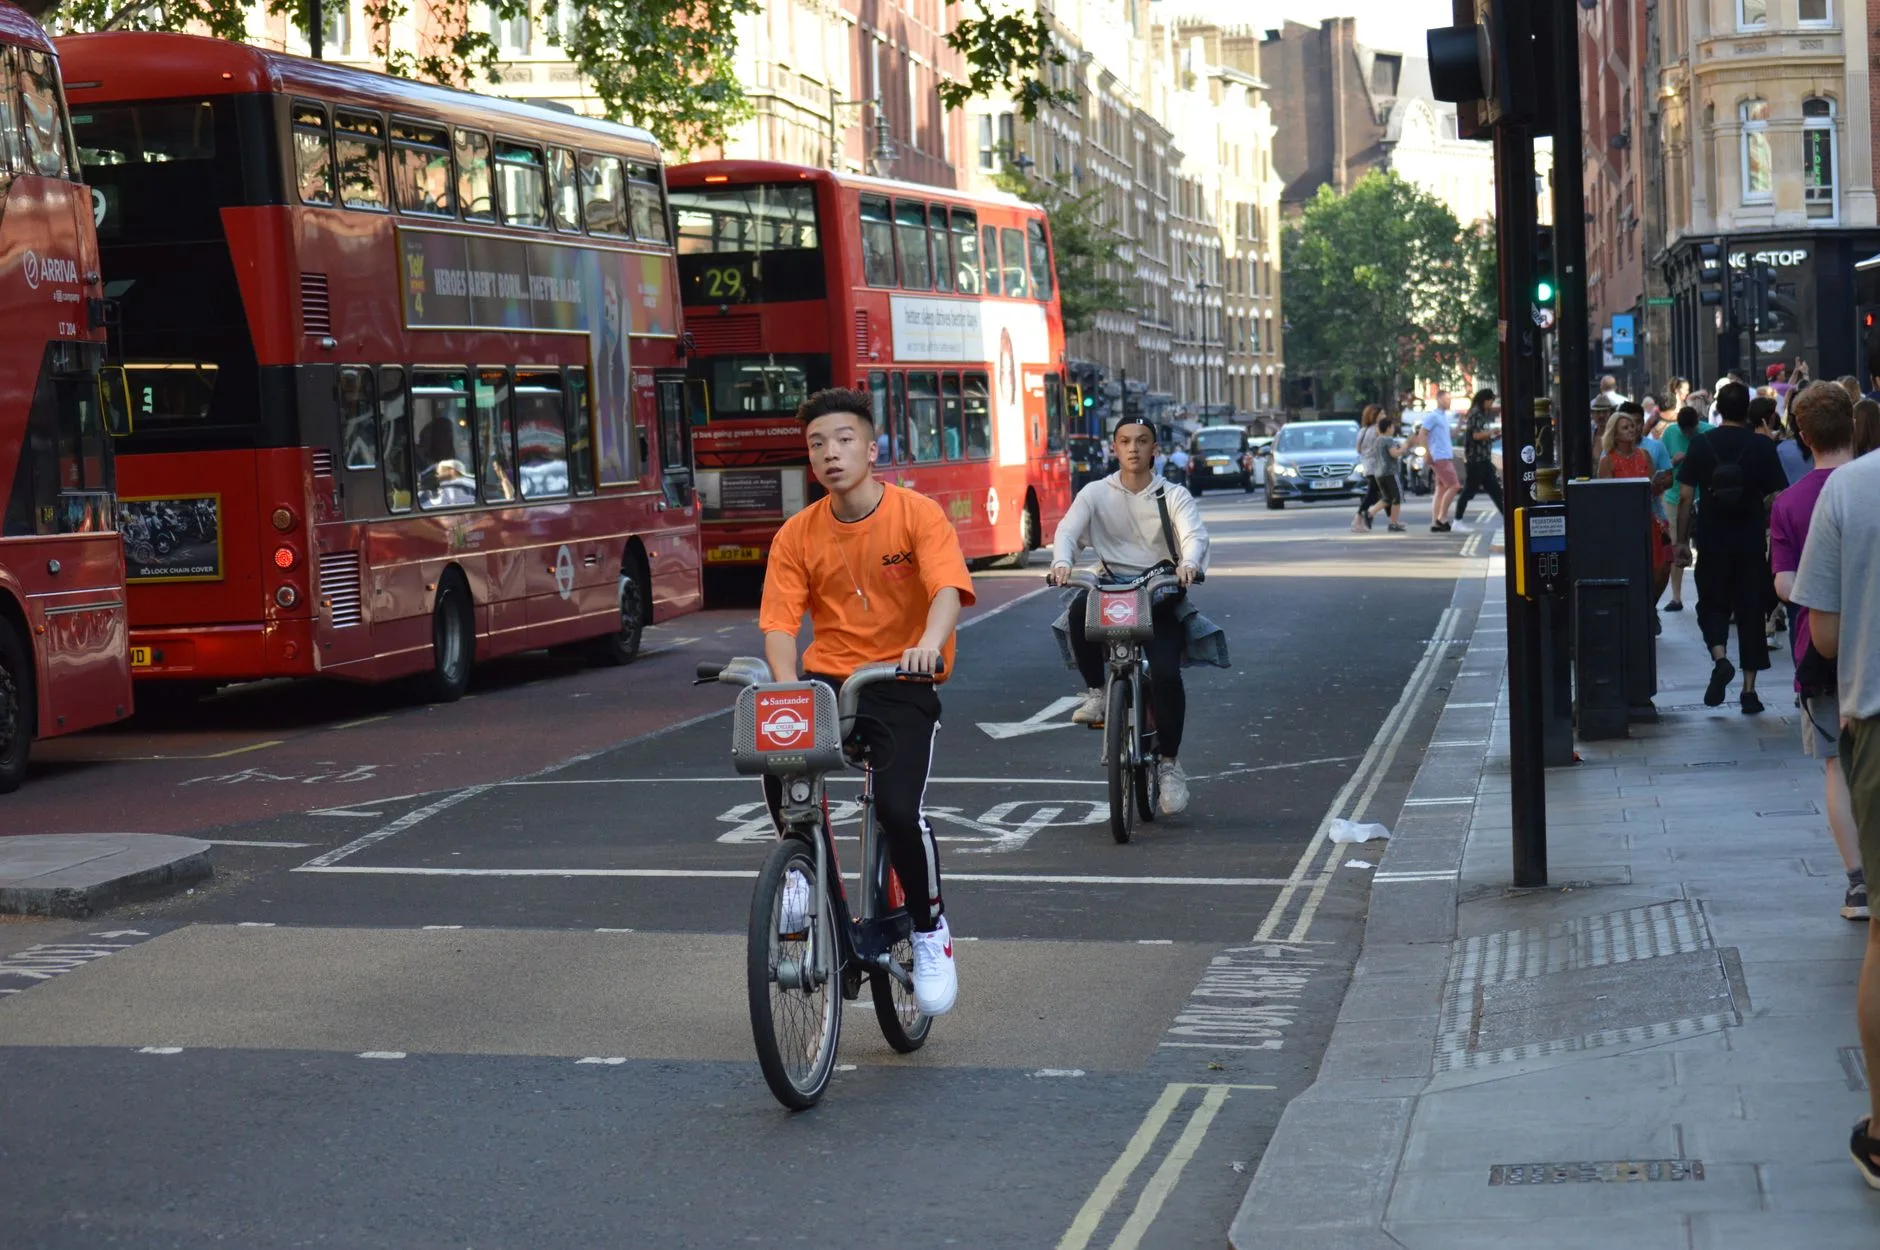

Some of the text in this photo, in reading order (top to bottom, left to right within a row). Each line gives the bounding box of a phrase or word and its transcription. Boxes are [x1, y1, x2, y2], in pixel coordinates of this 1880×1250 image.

[40, 258, 79, 283] ARRIVA
[434, 268, 467, 296] HEROES
[468, 270, 497, 298] AREN'T
[560, 279, 582, 303] MADE
[707, 268, 741, 297] 29
[713, 430, 733, 440] going
[767, 427, 801, 436] LONDON
[882, 551, 912, 566] sex
[769, 696, 809, 706] Santander
